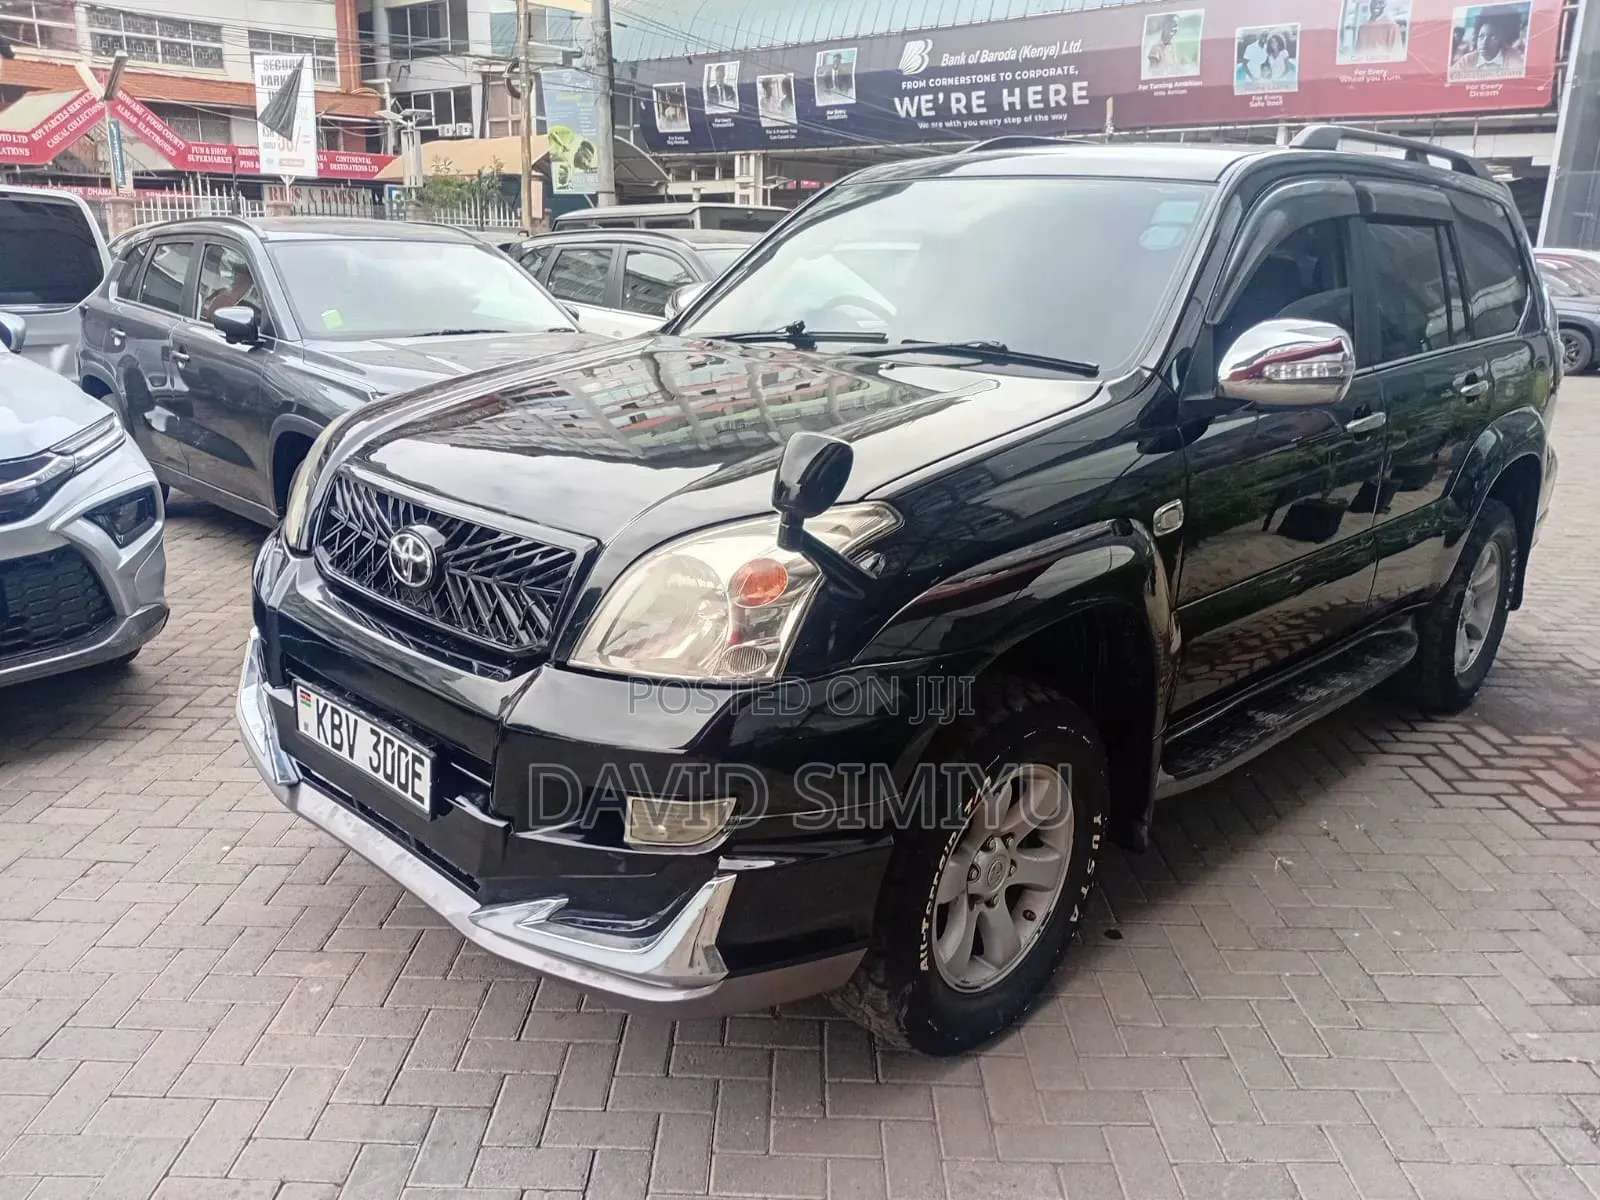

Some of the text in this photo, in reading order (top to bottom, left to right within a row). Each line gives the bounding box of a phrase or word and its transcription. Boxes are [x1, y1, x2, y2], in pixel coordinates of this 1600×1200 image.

[941, 40, 1083, 67] Bank of Baroda (Kenya) Ltd.
[901, 65, 1079, 90] FROM CORNERSTONE TO CORPORATE,
[893, 81, 1090, 119] WE'RE HERE
[43, 110, 70, 134] PARCELS
[116, 104, 138, 125] ALMAS
[136, 121, 177, 157] ELECTRONICS
[145, 113, 165, 132] FOOD
[162, 128, 186, 151] COURTS
[944, 118, 962, 128] with
[963, 118, 978, 129] you
[979, 117, 1002, 127] every
[1003, 114, 1022, 125] step
[1023, 114, 1033, 123] of
[1034, 113, 1049, 122] the
[1050, 112, 1068, 122] way
[12, 134, 29, 144] LTD
[191, 146, 205, 155] FUN
[210, 147, 228, 156] SHOP
[329, 162, 379, 174] DESTINATIONS LTD
[335, 155, 372, 165] CONTINENTAL
[315, 697, 426, 806] KBV 300E
